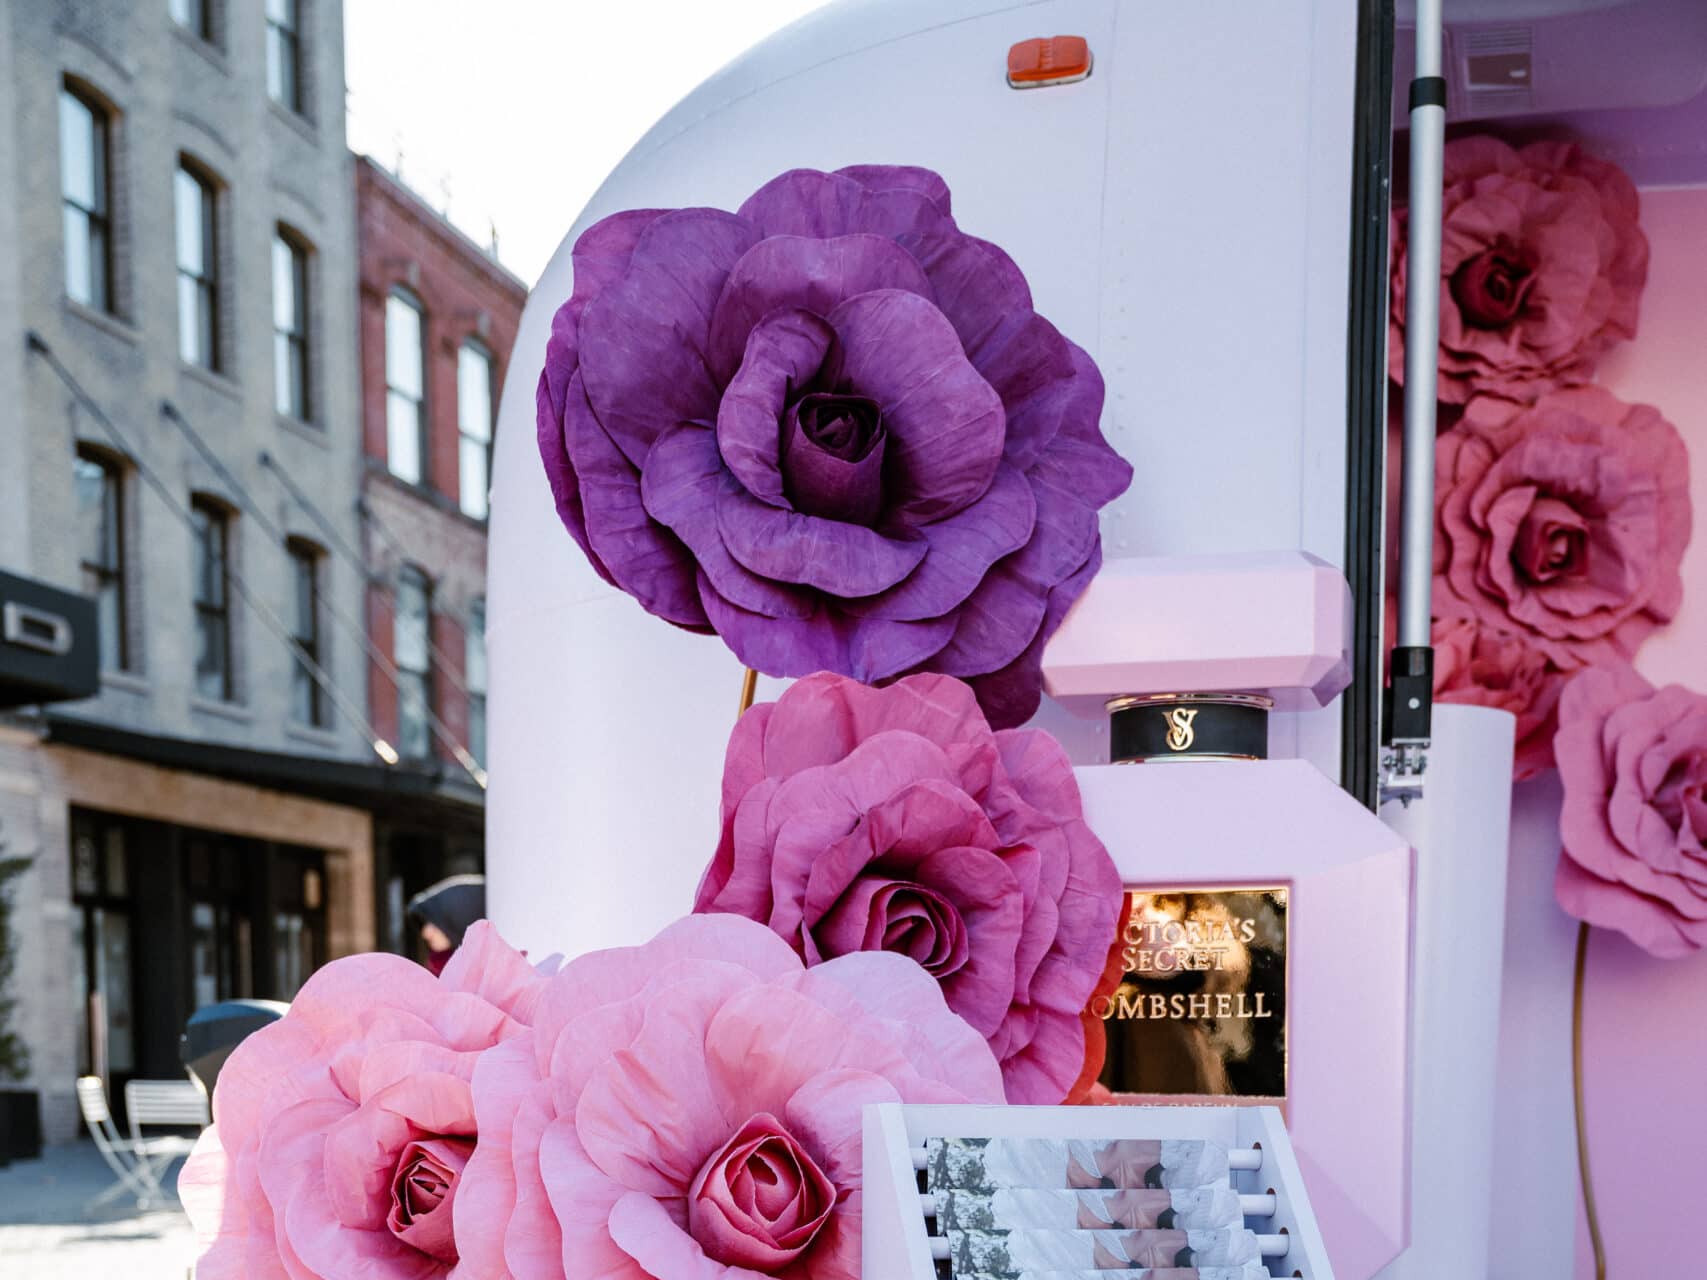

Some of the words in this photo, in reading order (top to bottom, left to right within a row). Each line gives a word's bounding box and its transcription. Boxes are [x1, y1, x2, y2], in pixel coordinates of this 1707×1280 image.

[1122, 918, 1256, 946] CTORIA'S
[1120, 946, 1229, 973] SECRET
[1089, 992, 1273, 1020] OMBSHELL
